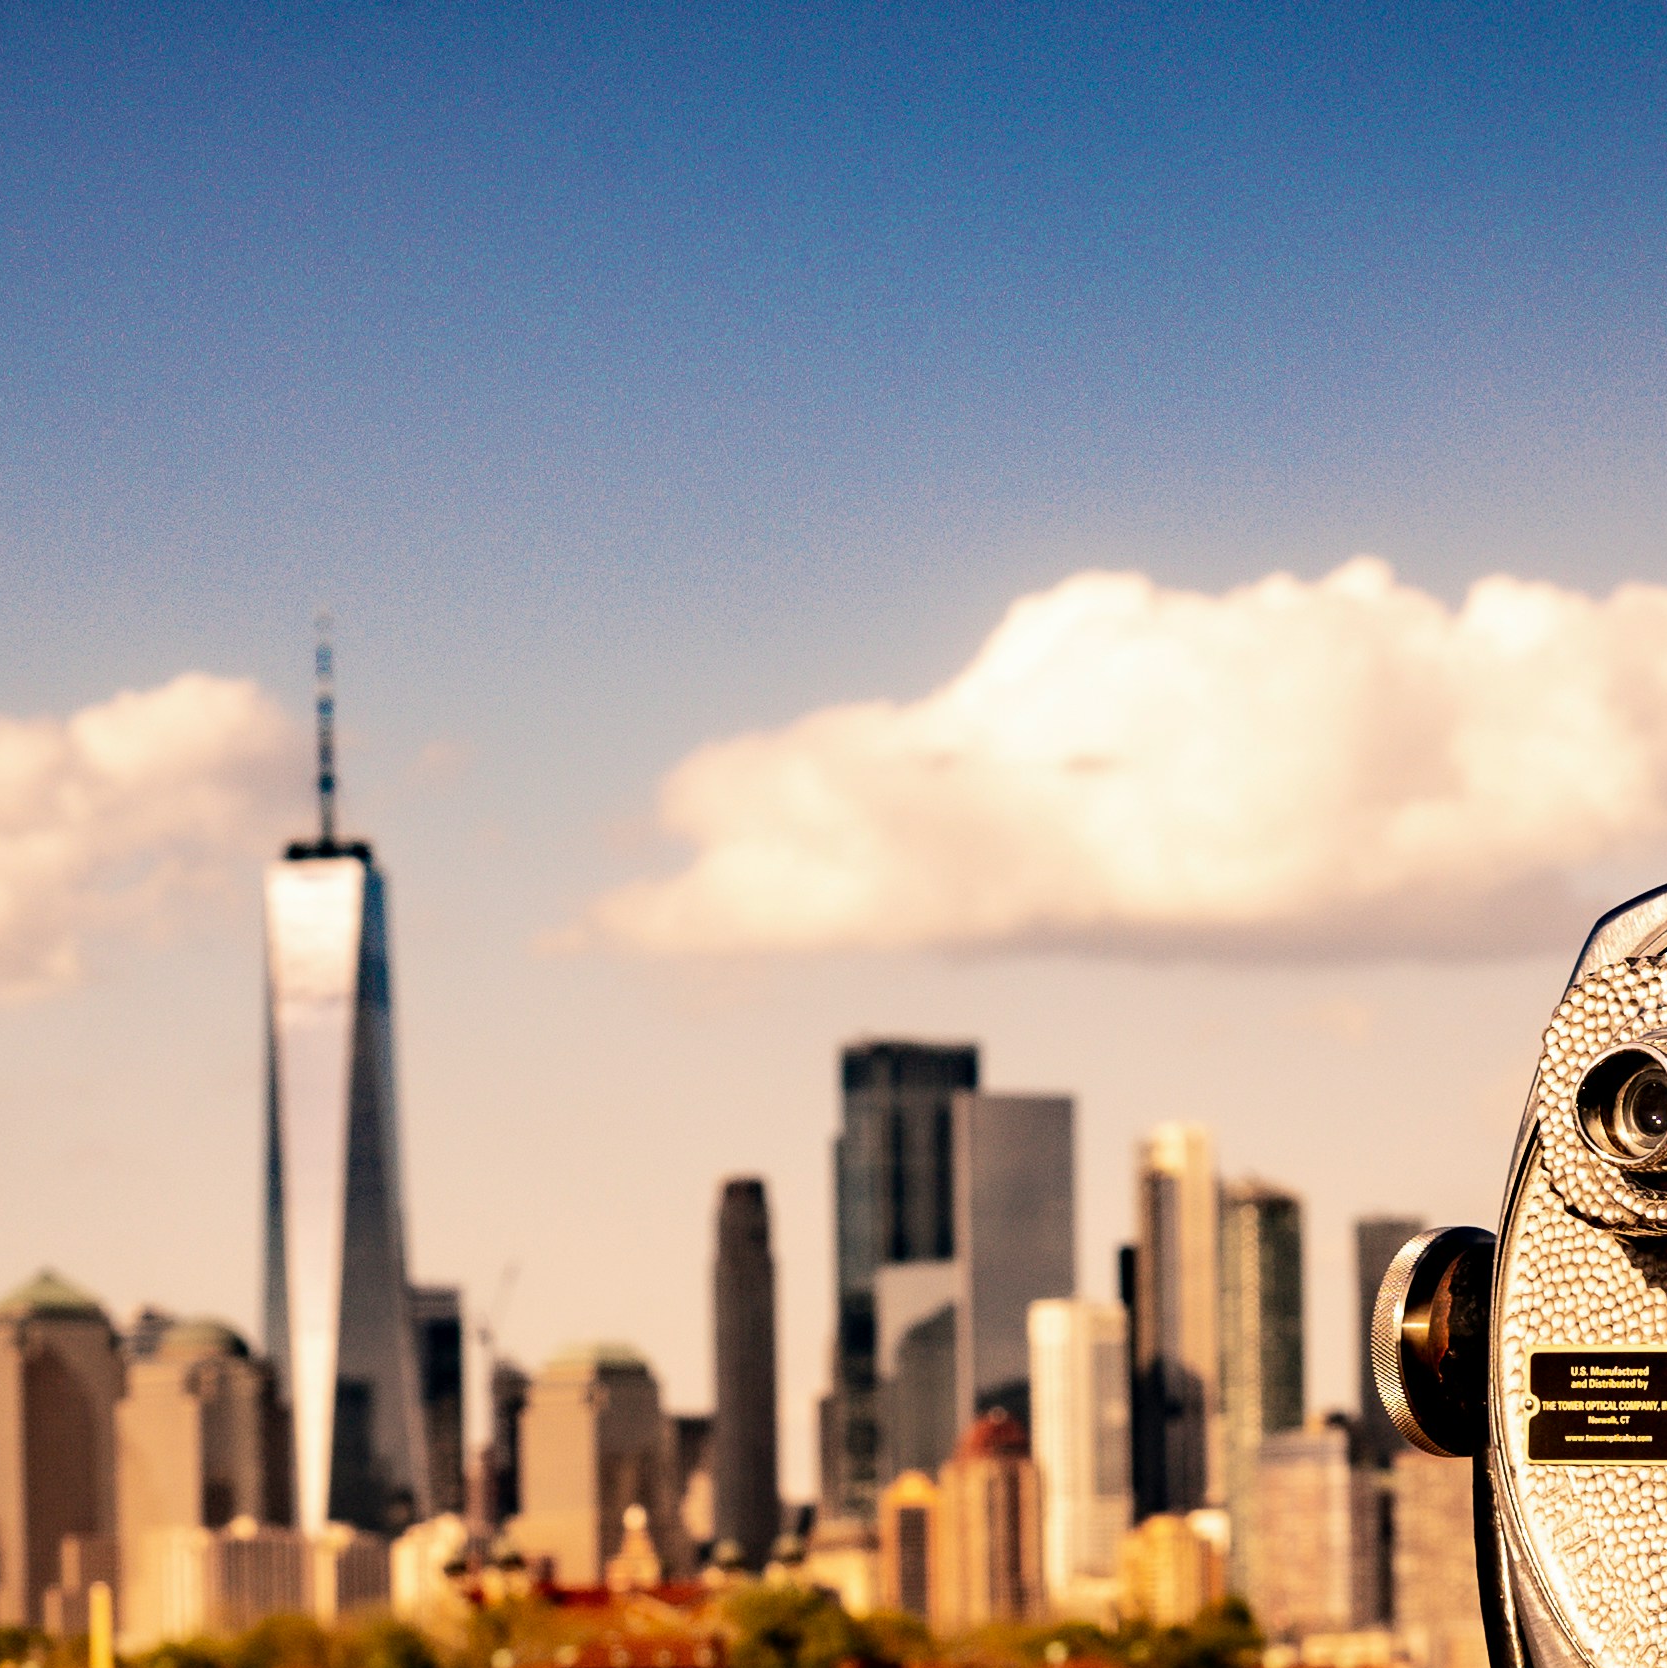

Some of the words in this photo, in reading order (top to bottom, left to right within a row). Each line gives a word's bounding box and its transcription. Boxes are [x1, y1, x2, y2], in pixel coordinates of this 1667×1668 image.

[1570, 1366, 1589, 1377] U.S.
[1590, 1365, 1650, 1377] Manufactured
[1570, 1379, 1587, 1389] and
[1588, 1378, 1636, 1389] Distributed
[1637, 1379, 1649, 1391] by
[1542, 1400, 1557, 1411] THE
[1558, 1400, 1585, 1411] TOWER
[1585, 1400, 1618, 1411] OPTICAL
[1618, 1400, 1661, 1413] COMPANY,
[1620, 1415, 1631, 1424] CT
